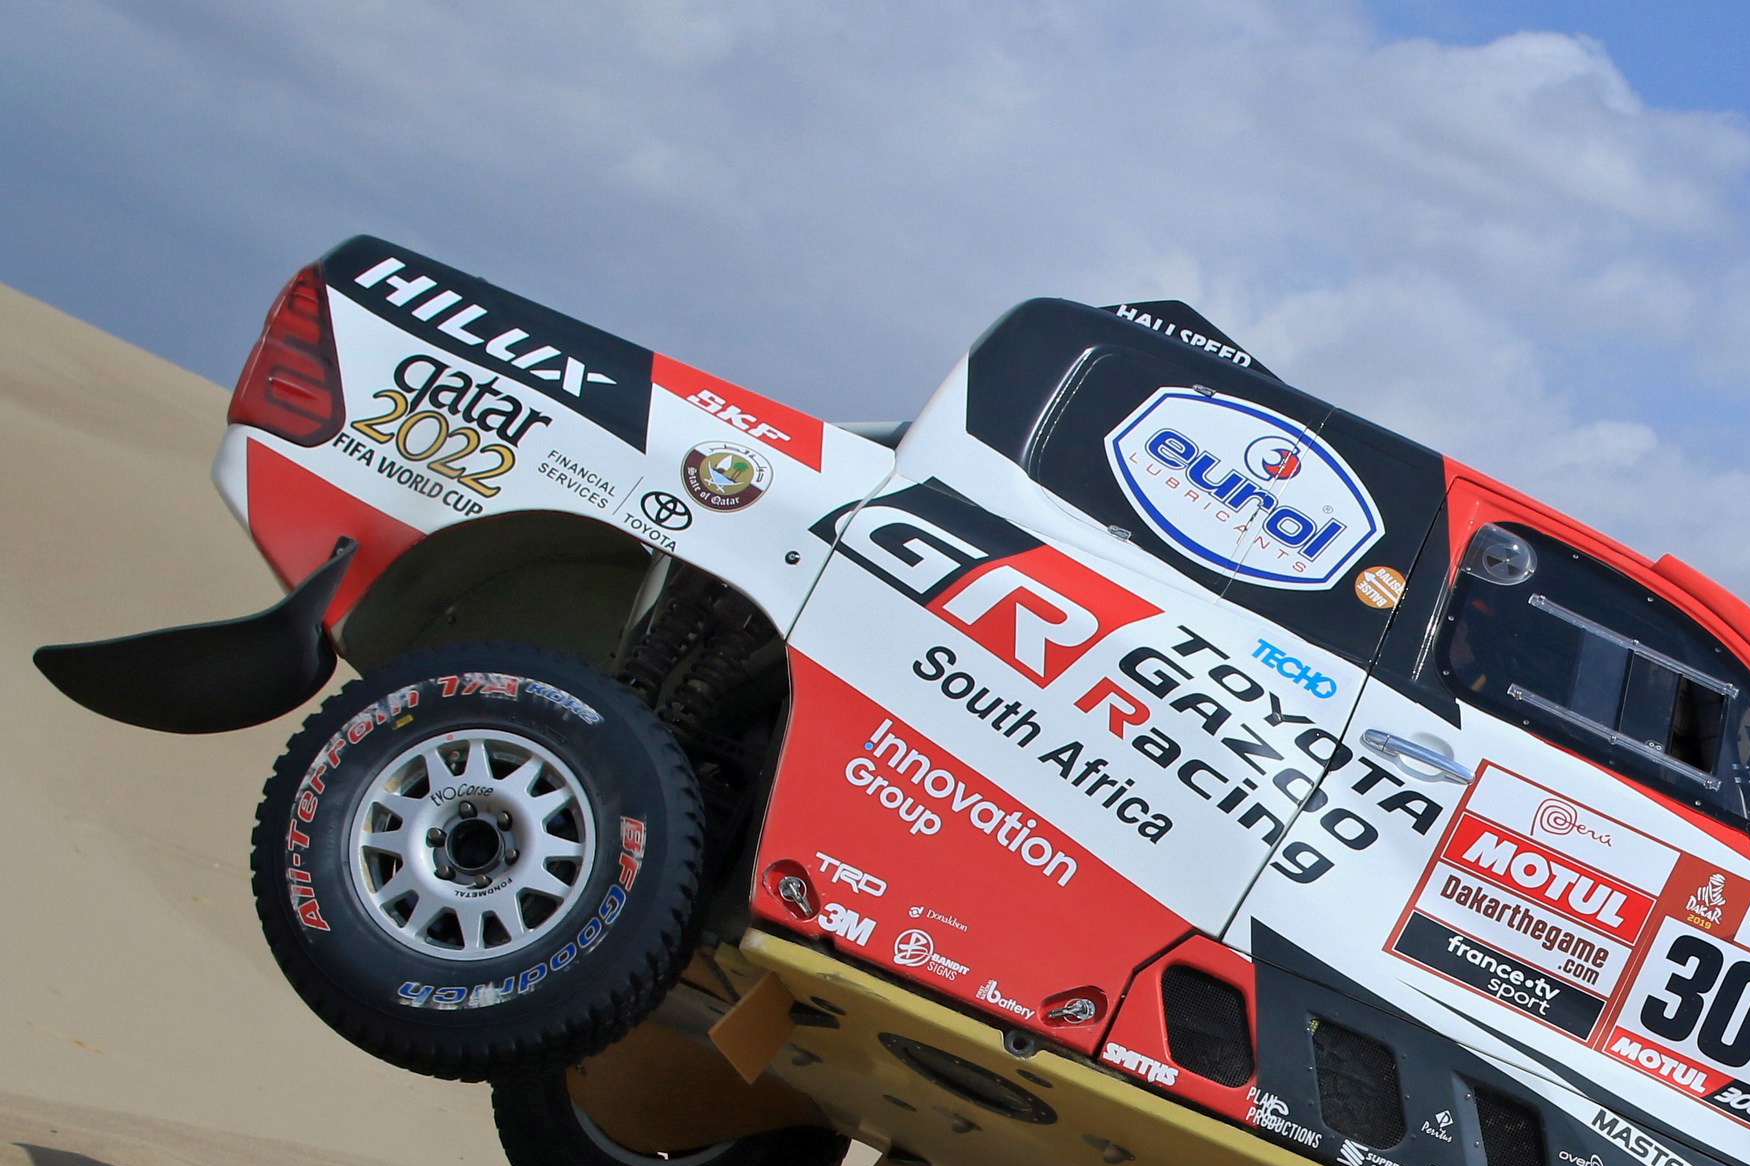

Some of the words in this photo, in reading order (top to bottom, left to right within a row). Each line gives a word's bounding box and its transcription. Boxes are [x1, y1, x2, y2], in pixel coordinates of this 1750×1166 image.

[354, 257, 617, 397] HILUX
[394, 354, 553, 448] qatar
[687, 389, 792, 445] SKF
[351, 390, 517, 498] 2022
[333, 432, 375, 468] FIFA
[376, 456, 444, 499] WORLD
[444, 490, 485, 519] CUP
[537, 462, 610, 509] SERVICES
[547, 449, 616, 498] FINANCIAL
[688, 467, 700, 492] State
[700, 491, 711, 500] of
[711, 495, 740, 506] Qatar
[1144, 428, 1347, 562] eurol
[623, 513, 678, 552] TOYOTA
[1129, 452, 1307, 572] LUBRICANTS
[1357, 580, 1388, 607] BALISE
[1251, 639, 1337, 699] TECHO
[912, 646, 1040, 748] South
[1038, 739, 1174, 845] Africa
[1118, 646, 1380, 852] GAZOO
[1161, 624, 1444, 837] TOYOTA
[844, 756, 943, 836] Group
[1073, 677, 1334, 884] Racing
[454, 877, 513, 898] FONDMETAL
[815, 851, 888, 898] TRD
[1461, 831, 1628, 929] MOTUL
[398, 815, 648, 1008] BFGoodrich
[817, 902, 878, 947] 3M
[927, 909, 968, 933] Donaldson
[1440, 874, 1610, 970] Dakarthegame
[1686, 895, 1722, 925] DAKAR
[1687, 914, 1712, 929] 2019
[927, 961, 958, 981] SIGNS
[931, 953, 970, 976] BANDIT
[1558, 957, 1600, 986] .com
[987, 980, 1036, 1020] battery
[1487, 977, 1550, 1016] sport
[1102, 1043, 1179, 1086] SMITHS
[1609, 1036, 1708, 1094] MOTUL
[1246, 1087, 1278, 1108] PLAN
[1246, 1107, 1323, 1148] PRODUCTIONS
[1421, 1121, 1452, 1143] Peritus
